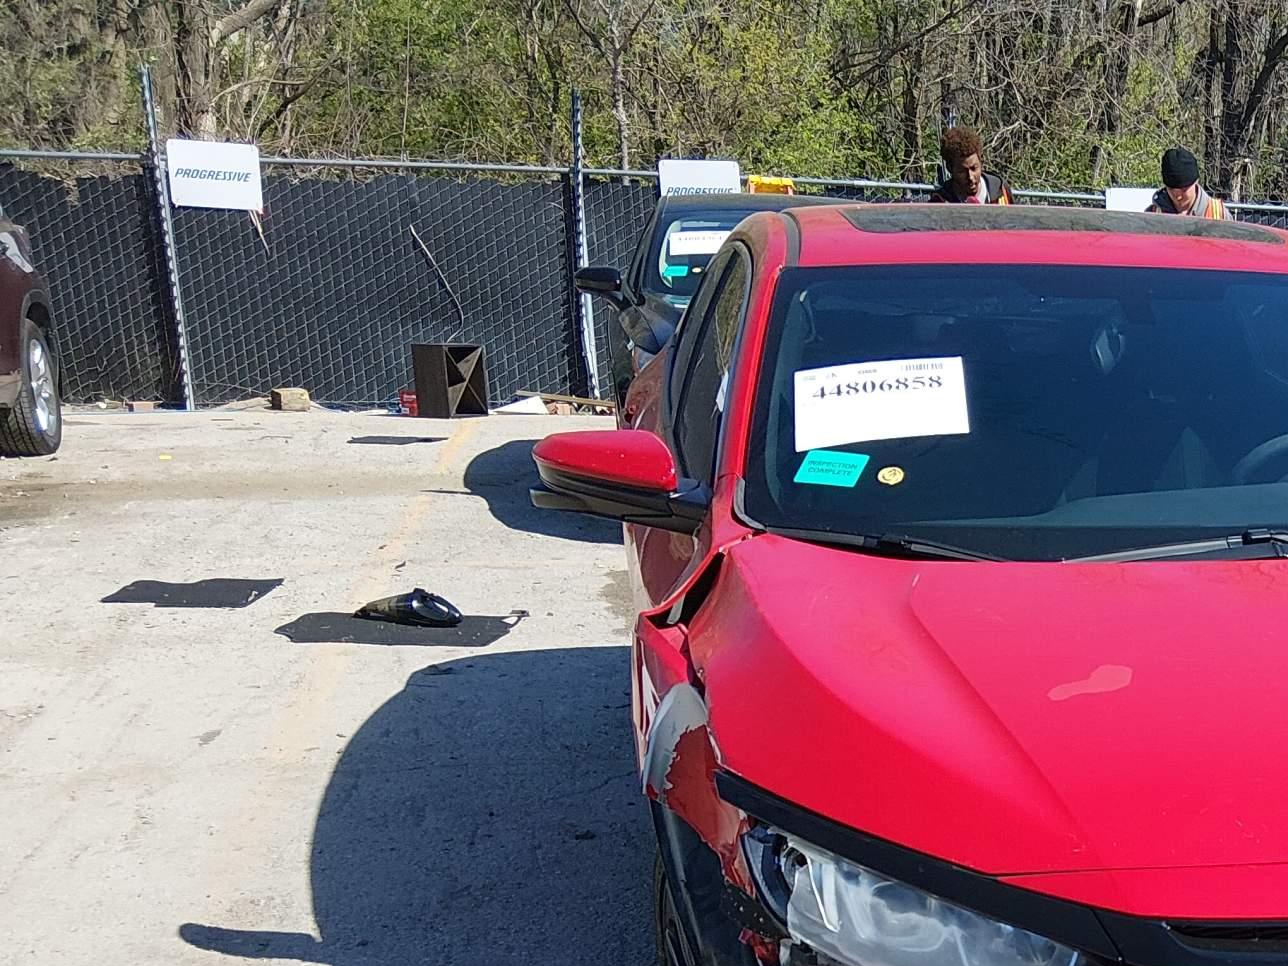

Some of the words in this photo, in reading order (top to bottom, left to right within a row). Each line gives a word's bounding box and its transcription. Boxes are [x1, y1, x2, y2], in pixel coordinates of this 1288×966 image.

[174, 167, 252, 183] PROGRESSIVE
[812, 374, 943, 399] 44806858
[807, 460, 859, 470] INSPECTION
[807, 466, 852, 477] COMPLETE
